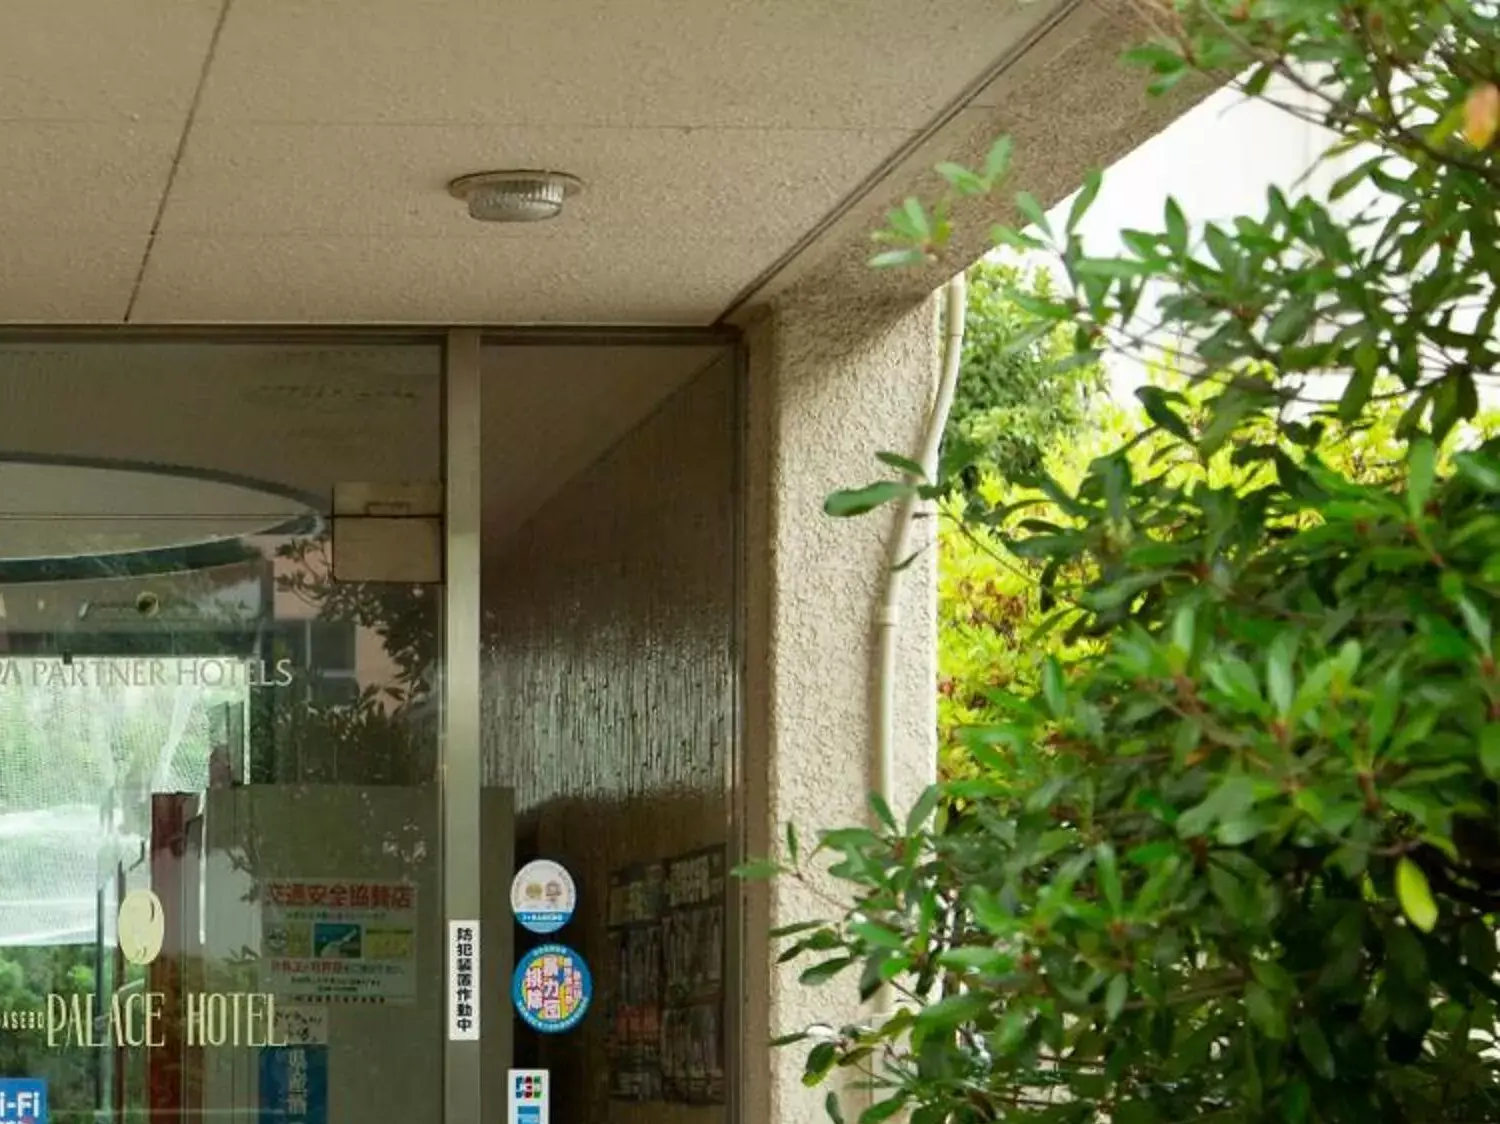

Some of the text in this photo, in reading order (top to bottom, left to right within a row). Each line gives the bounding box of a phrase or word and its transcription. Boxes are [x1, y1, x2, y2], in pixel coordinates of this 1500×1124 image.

[32, 657, 166, 688] PARTNER
[176, 657, 294, 688] HOTELS
[456, 927, 473, 1033] 防犯装置作動中
[46, 992, 166, 1048] PALACE
[187, 992, 288, 1048] HOTEL
